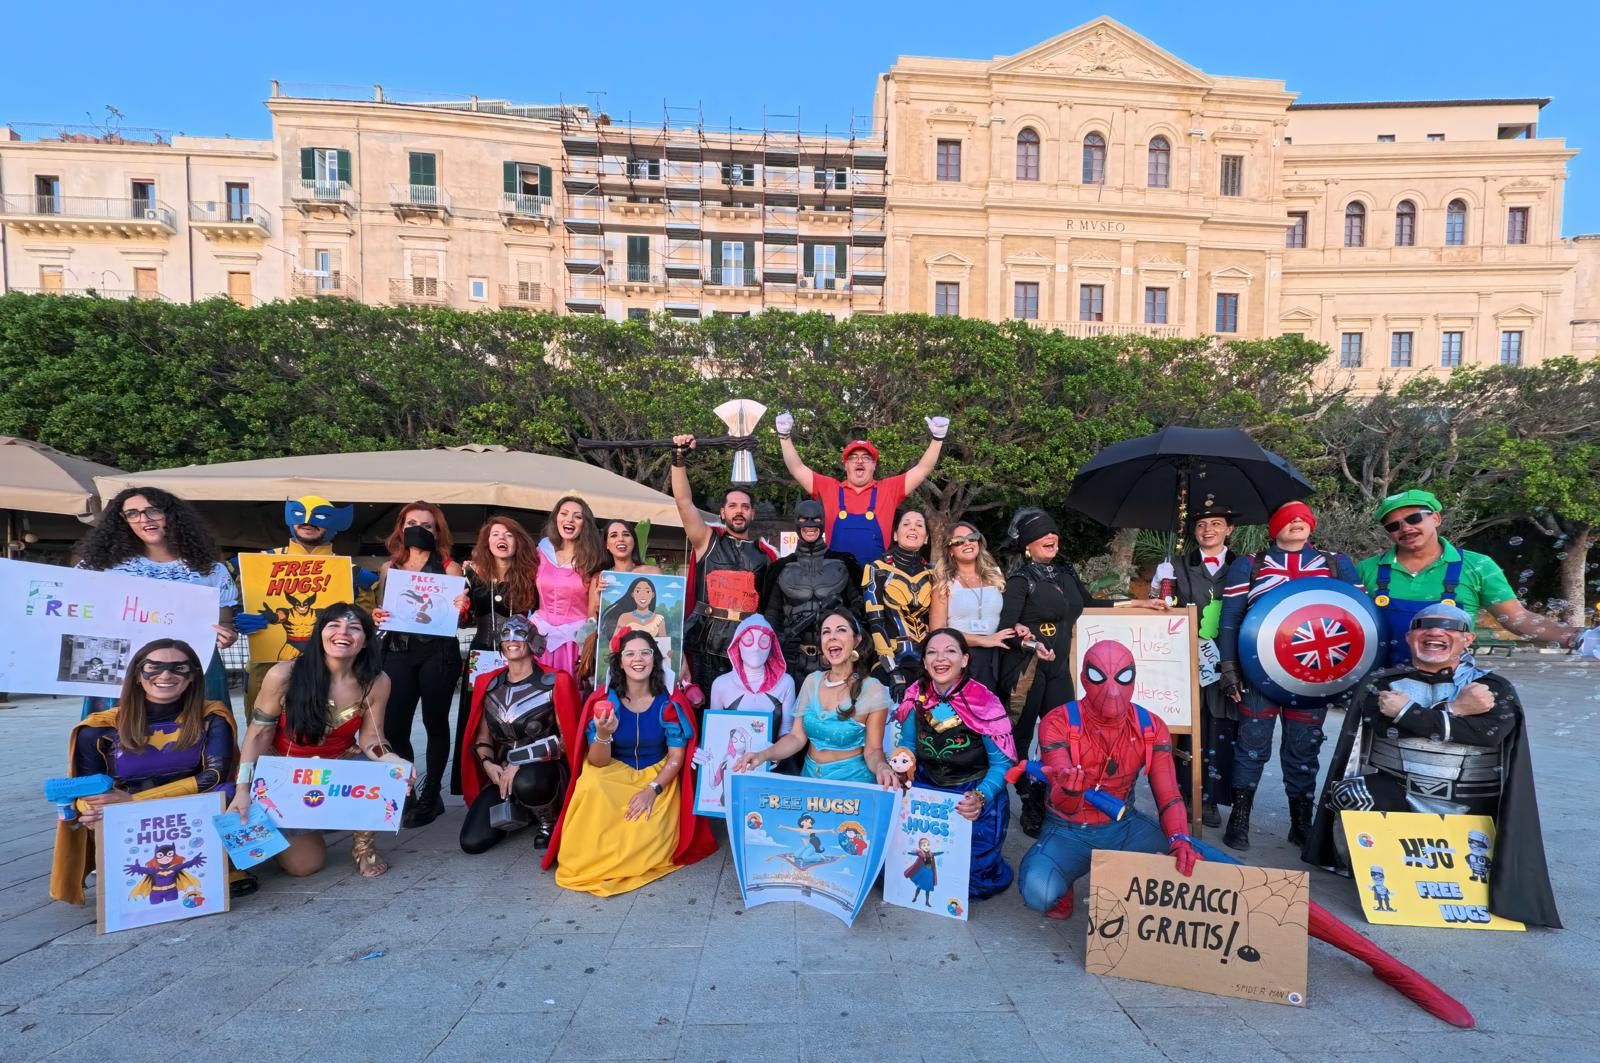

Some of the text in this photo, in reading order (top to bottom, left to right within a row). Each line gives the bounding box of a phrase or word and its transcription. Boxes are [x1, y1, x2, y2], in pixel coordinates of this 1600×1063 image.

[1080, 220, 1126, 233] MVSEO
[270, 560, 326, 578] FREE
[266, 574, 332, 596] HUGS!
[411, 574, 435, 584] FREE
[293, 768, 333, 785] FREE
[328, 784, 381, 800] HUGS
[760, 793, 861, 816] FREE HUGS!
[910, 799, 950, 820] FREE
[140, 813, 188, 832] FREE
[906, 815, 950, 837] HUGS
[136, 826, 192, 845] HUGS
[1124, 876, 1239, 916] ABBRACCI
[1416, 881, 1463, 900] FREE
[1440, 905, 1492, 924] HUGS
[1137, 915, 1240, 965] GRATIS!
